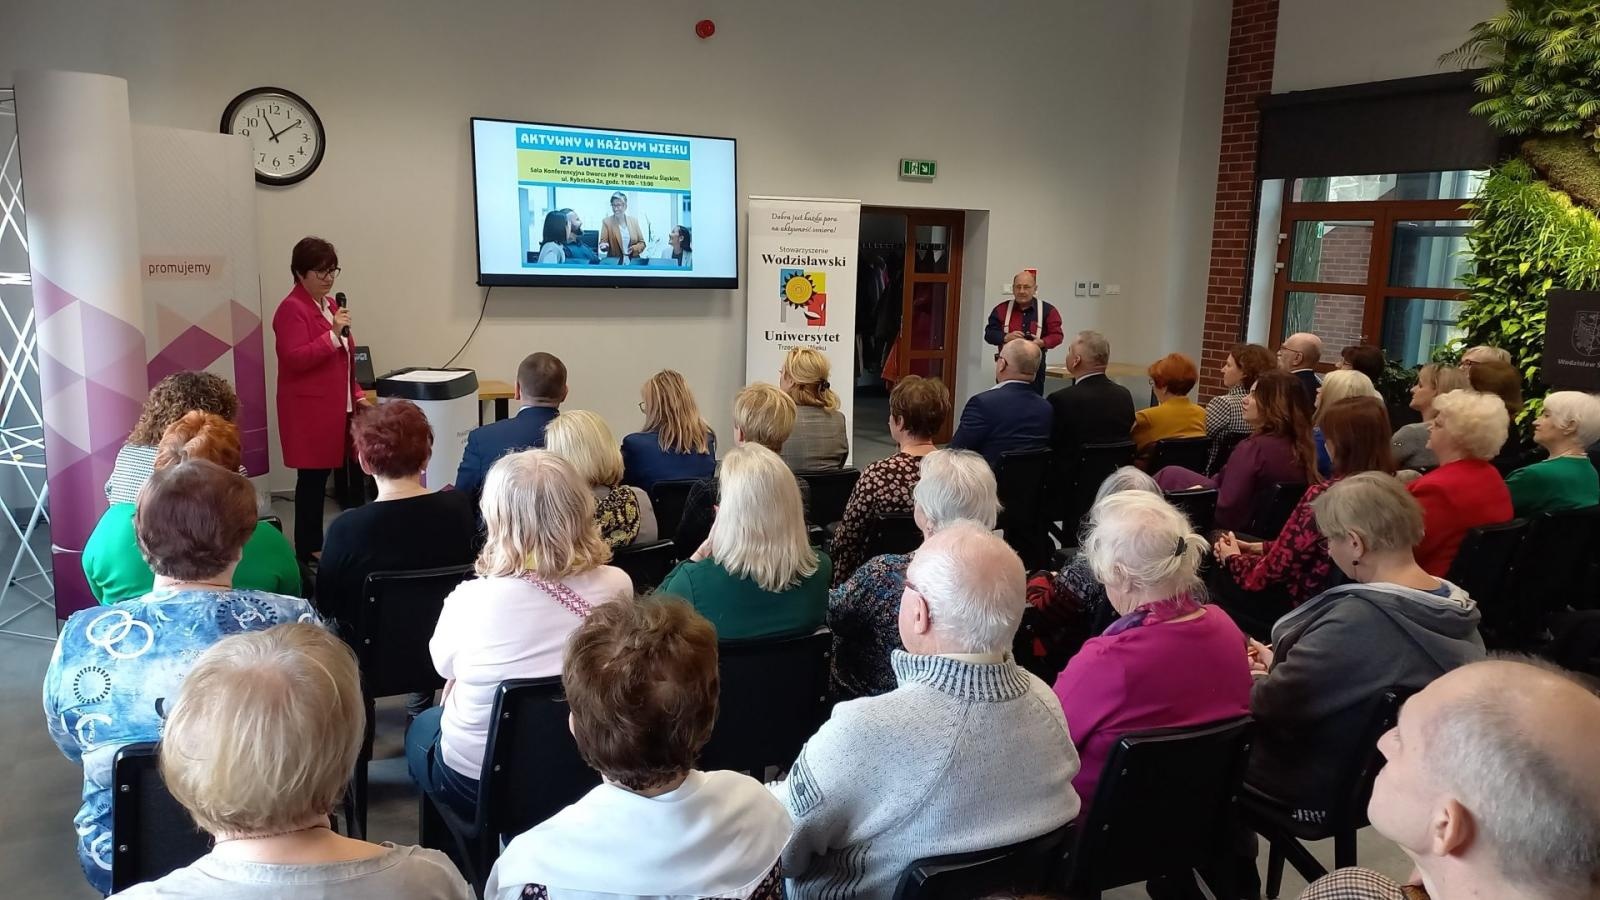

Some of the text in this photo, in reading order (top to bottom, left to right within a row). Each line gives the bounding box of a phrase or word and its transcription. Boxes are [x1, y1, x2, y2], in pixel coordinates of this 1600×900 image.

[256, 107, 266, 118] 11
[268, 104, 281, 115] 12
[286, 109, 291, 119] 1
[246, 117, 259, 128] 10
[241, 128, 250, 137] 9
[302, 133, 309, 143] 3
[520, 133, 688, 155] AKTYWNY W KAŻDYM WIEKU
[297, 145, 304, 156] 4
[259, 152, 266, 162] 7
[272, 157, 281, 167] 6
[288, 154, 295, 164] 5
[560, 155, 650, 170] 27 LUTEGO 2024
[543, 168, 584, 177] Konferencyjna
[771, 211, 791, 220] Dobra
[779, 246, 829, 254] Stowarzyszenie
[761, 254, 846, 267] Wodzisławski
[148, 261, 211, 276] promujemy
[764, 330, 840, 344] Uniwersytet
